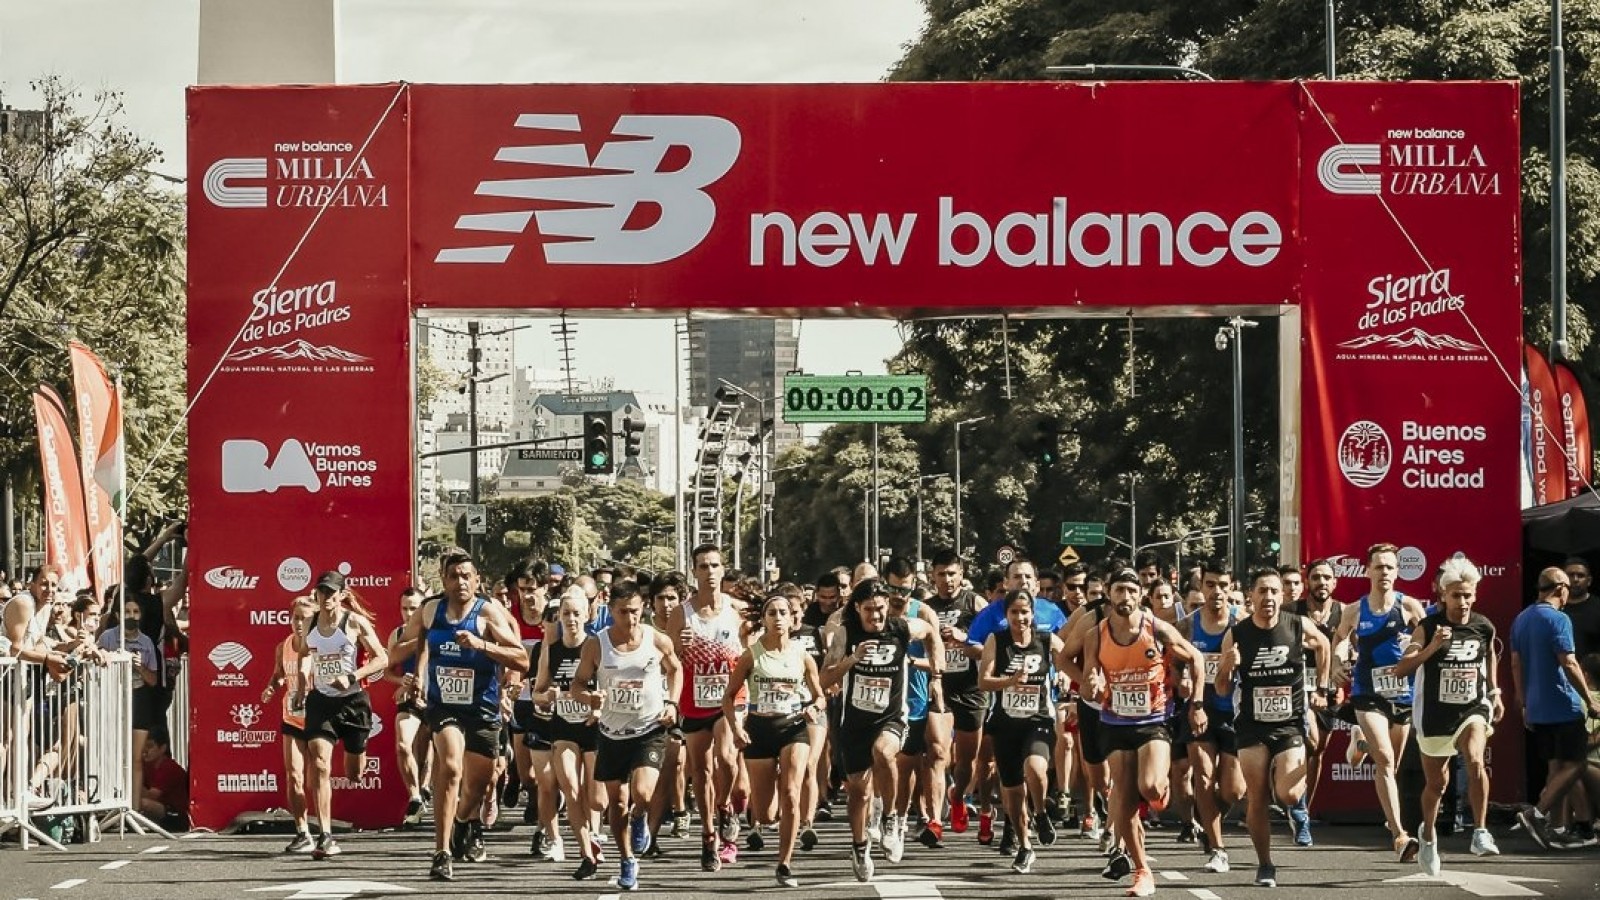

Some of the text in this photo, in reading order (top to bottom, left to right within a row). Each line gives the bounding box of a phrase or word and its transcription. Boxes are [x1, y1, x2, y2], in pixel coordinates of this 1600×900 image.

[1387, 127, 1465, 139] new balance
[274, 140, 353, 152] new balance
[1389, 144, 1488, 167] MILLA
[276, 157, 375, 180] MILLA
[1389, 172, 1502, 195] URBANA
[276, 184, 389, 207] URBANA
[749, 196, 1282, 267] new balance
[1366, 268, 1451, 309] Sierra
[251, 280, 337, 321] Sierra
[1358, 294, 1465, 330] de los Padres
[242, 305, 351, 342] de los Padres
[787, 386, 925, 412] 00:00:02
[1402, 420, 1487, 441] Buenos
[305, 442, 361, 456] Vamos
[522, 450, 579, 460] SARMIENTO
[1402, 444, 1464, 465] Aires
[221, 438, 321, 493] BA
[316, 458, 377, 471] Buenos
[326, 473, 372, 487] Aires
[1402, 468, 1484, 489] Ciudad
[1000, 552, 1011, 562] 20
[280, 573, 309, 582] Running
[1338, 565, 1367, 577] MIL
[223, 575, 260, 589] MILE
[250, 611, 291, 625] MEG
[1444, 679, 1473, 694] 1095
[1007, 694, 1037, 708] 1285
[1116, 693, 1146, 706] 1149
[217, 729, 277, 743] BeePower
[218, 769, 278, 792] amanda
